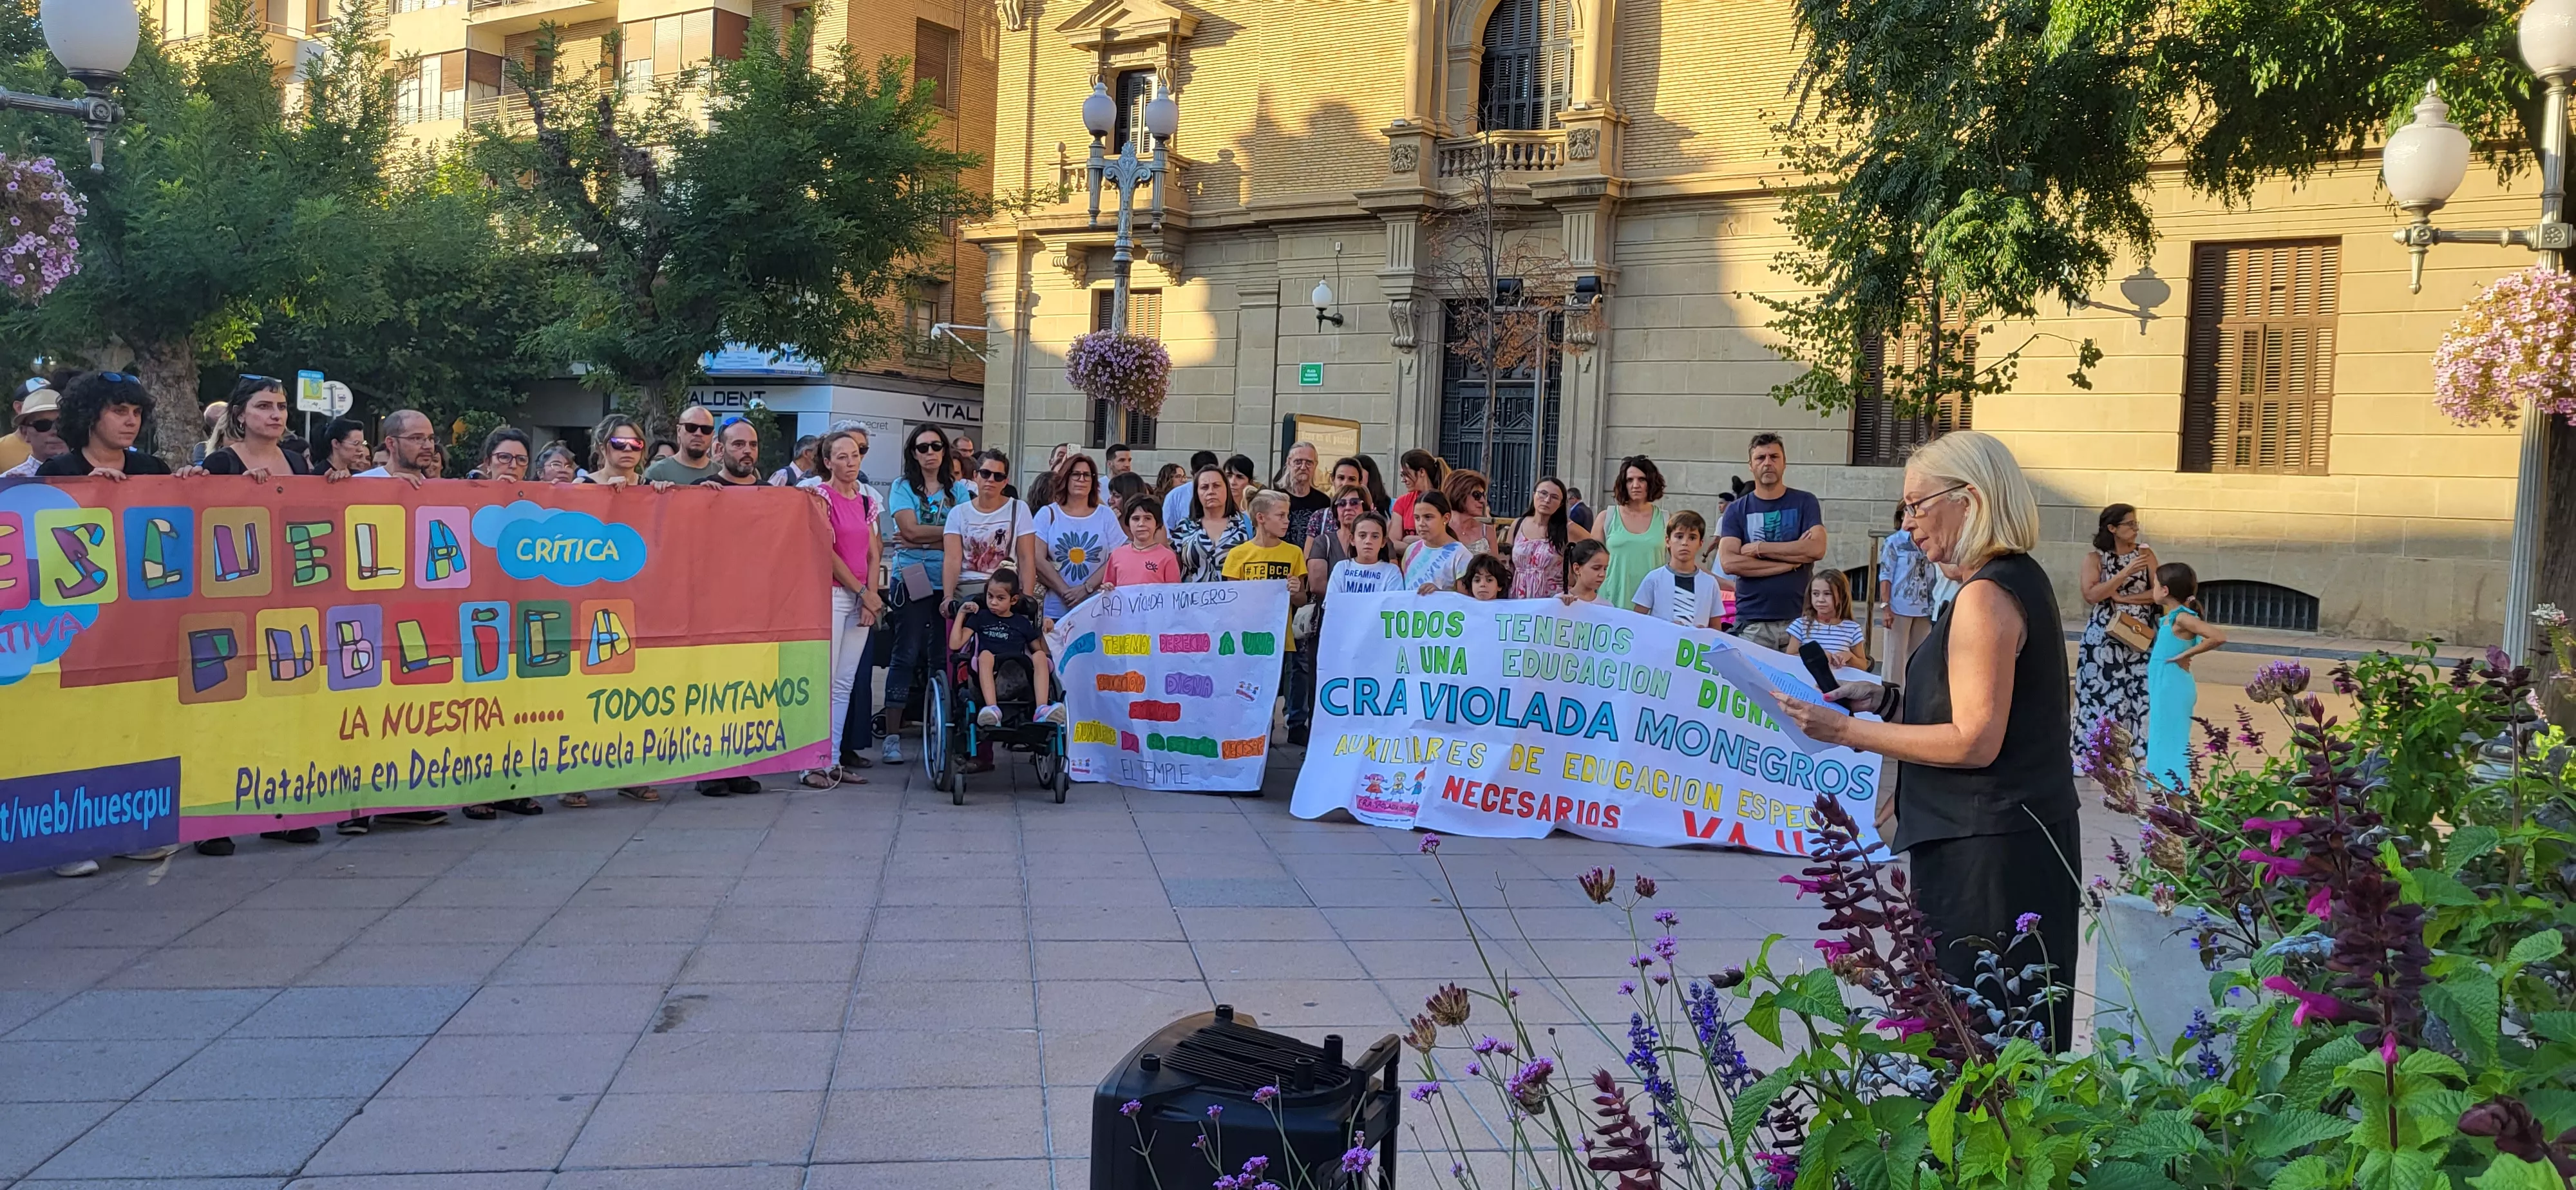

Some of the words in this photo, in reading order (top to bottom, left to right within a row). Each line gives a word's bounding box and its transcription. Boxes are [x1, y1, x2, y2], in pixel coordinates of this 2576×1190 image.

[922, 401, 983, 422] VITAL
[516, 534, 620, 563] CRÍTICA
[1345, 569, 1381, 580] DREAMING
[1346, 581, 1376, 593] MIAMI
[1673, 585, 1695, 627] NIK
[0, 612, 86, 653] TIVA
[1381, 610, 1464, 639] TODOS
[1495, 613, 1634, 655] TENEMOS
[1165, 672, 1213, 698] DIGNA
[1396, 646, 1410, 674] A
[1420, 646, 1468, 675] UNA
[1502, 648, 1672, 700] EDUCACION
[339, 705, 370, 741] LA
[383, 696, 505, 738] NUESTRA
[587, 685, 676, 724] TODOS
[685, 677, 810, 717] PINTAMOS
[1320, 677, 1408, 717] CRA
[1420, 681, 1618, 742] VIOLADA
[1635, 707, 1874, 801] MONEGROS
[235, 760, 362, 812] Plataforma
[373, 760, 399, 793] en
[410, 747, 493, 789] Defensa
[502, 741, 524, 775] de
[532, 739, 549, 771] la
[556, 730, 634, 773] Escuela
[643, 725, 712, 766] Pública
[721, 719, 787, 757] HUESCA
[1121, 759, 1137, 780] EL
[1137, 760, 1191, 784] TEMPLE
[1333, 734, 1488, 769] AUXILIARES
[1509, 743, 1544, 775] DE
[1562, 751, 1723, 812] EDUCACION
[1738, 788, 1865, 838] ESPEC
[1442, 775, 1622, 829] NECESARIOS
